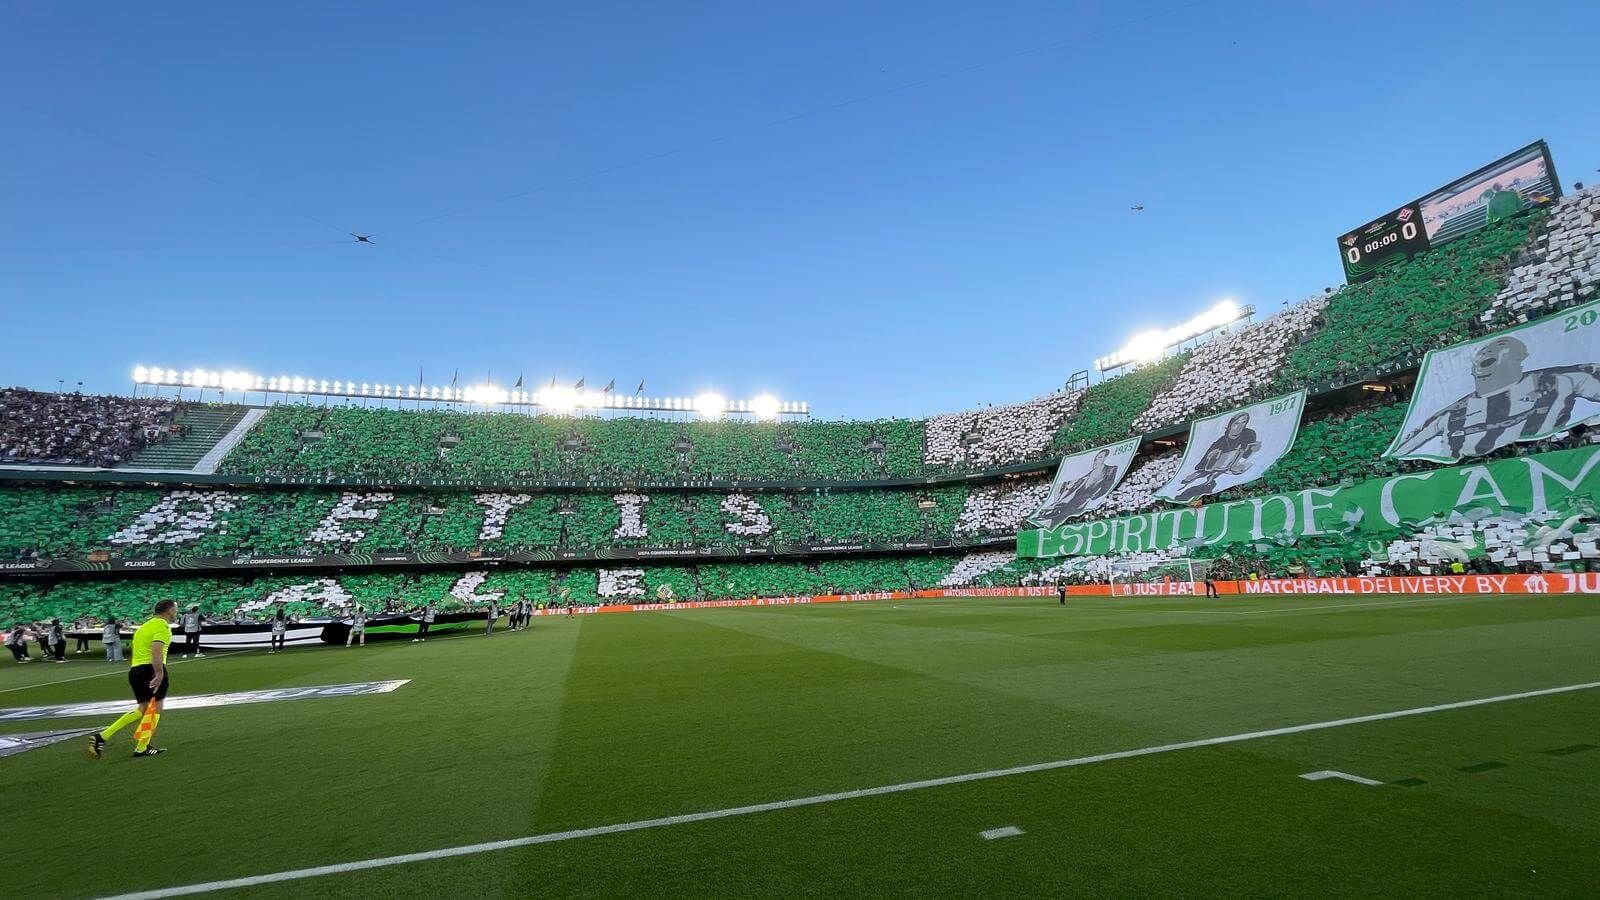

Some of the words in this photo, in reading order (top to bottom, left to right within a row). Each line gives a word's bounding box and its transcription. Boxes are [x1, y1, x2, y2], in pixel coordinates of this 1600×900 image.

[1347, 247, 1360, 264] 0
[1365, 232, 1397, 253] 00:00
[1401, 222, 1417, 240] 0
[1036, 501, 1244, 558] ESPIRITU
[944, 588, 975, 597] MATCHBALL
[976, 587, 1006, 597] DELIVERY
[1007, 587, 1016, 596] BY
[1026, 586, 1047, 596] JUST
[1049, 586, 1061, 596] EA
[1135, 582, 1165, 595] JUST
[1245, 580, 1355, 593] MATCHBALL
[1359, 577, 1466, 593] DELIVERY
[1476, 576, 1508, 593] BY
